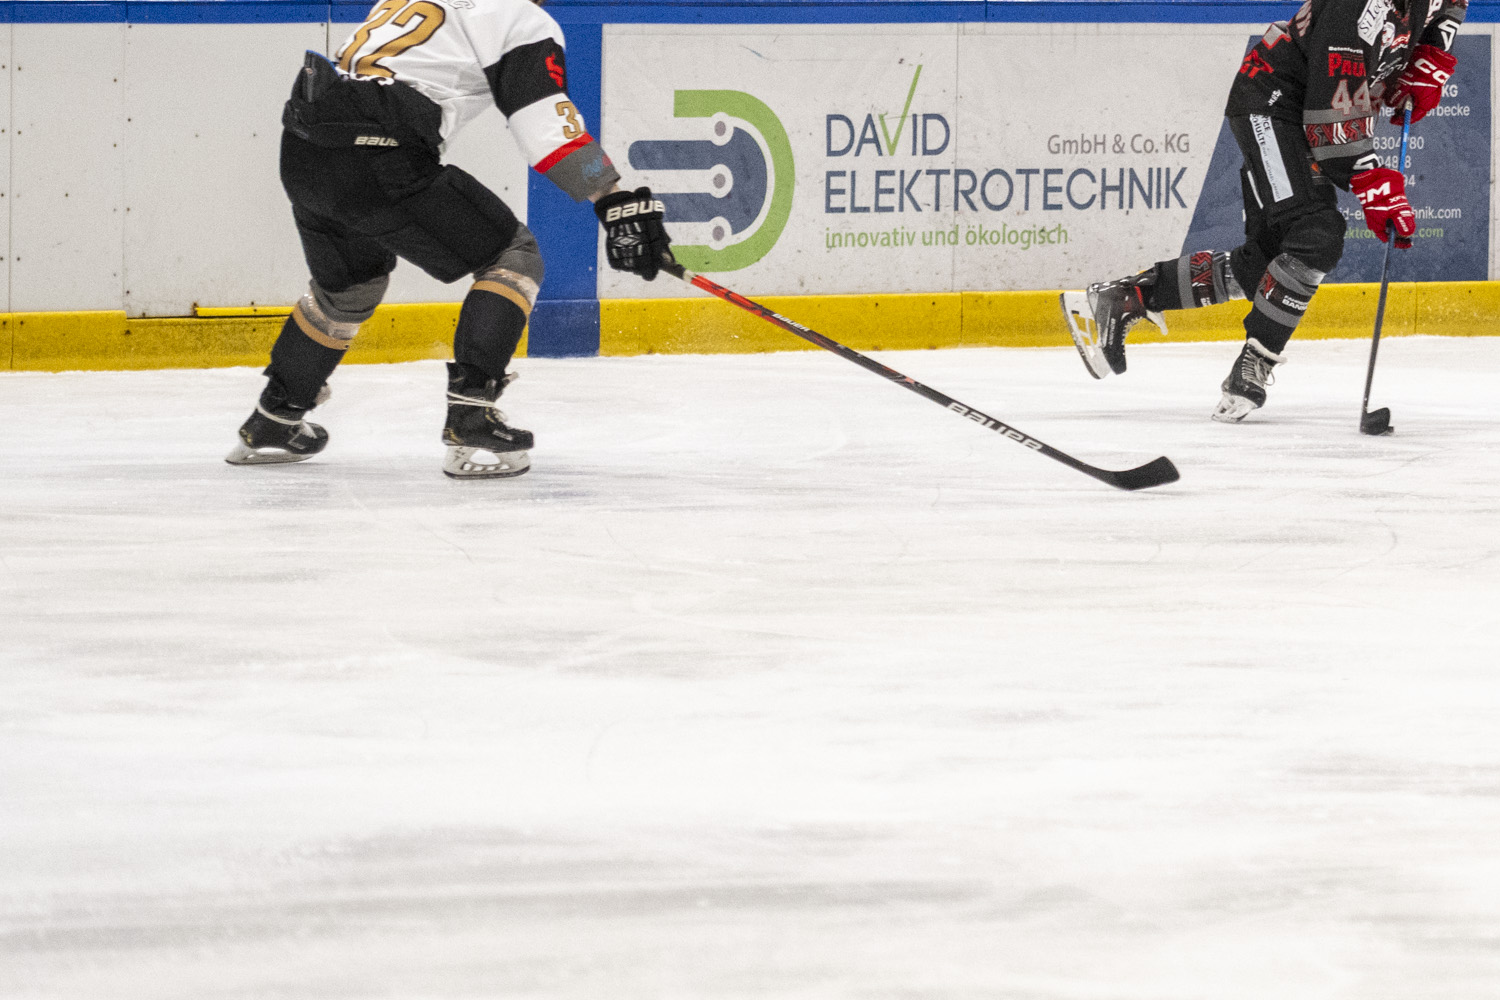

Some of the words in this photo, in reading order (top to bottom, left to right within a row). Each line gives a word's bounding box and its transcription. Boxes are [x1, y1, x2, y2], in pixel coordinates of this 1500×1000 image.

[1328, 52, 1366, 77] PAU
[555, 100, 584, 140] 3
[1047, 133, 1107, 155] GmbH
[1111, 133, 1126, 154] &
[1130, 133, 1160, 154] Co.
[1164, 132, 1191, 154] KG
[1372, 136, 1425, 151] 630480
[824, 166, 1189, 214] ELEKTROTECHNIK
[605, 199, 666, 223] BAUE
[825, 227, 916, 249] innovativ
[921, 225, 960, 247] und
[965, 222, 1069, 251] ökologisch
